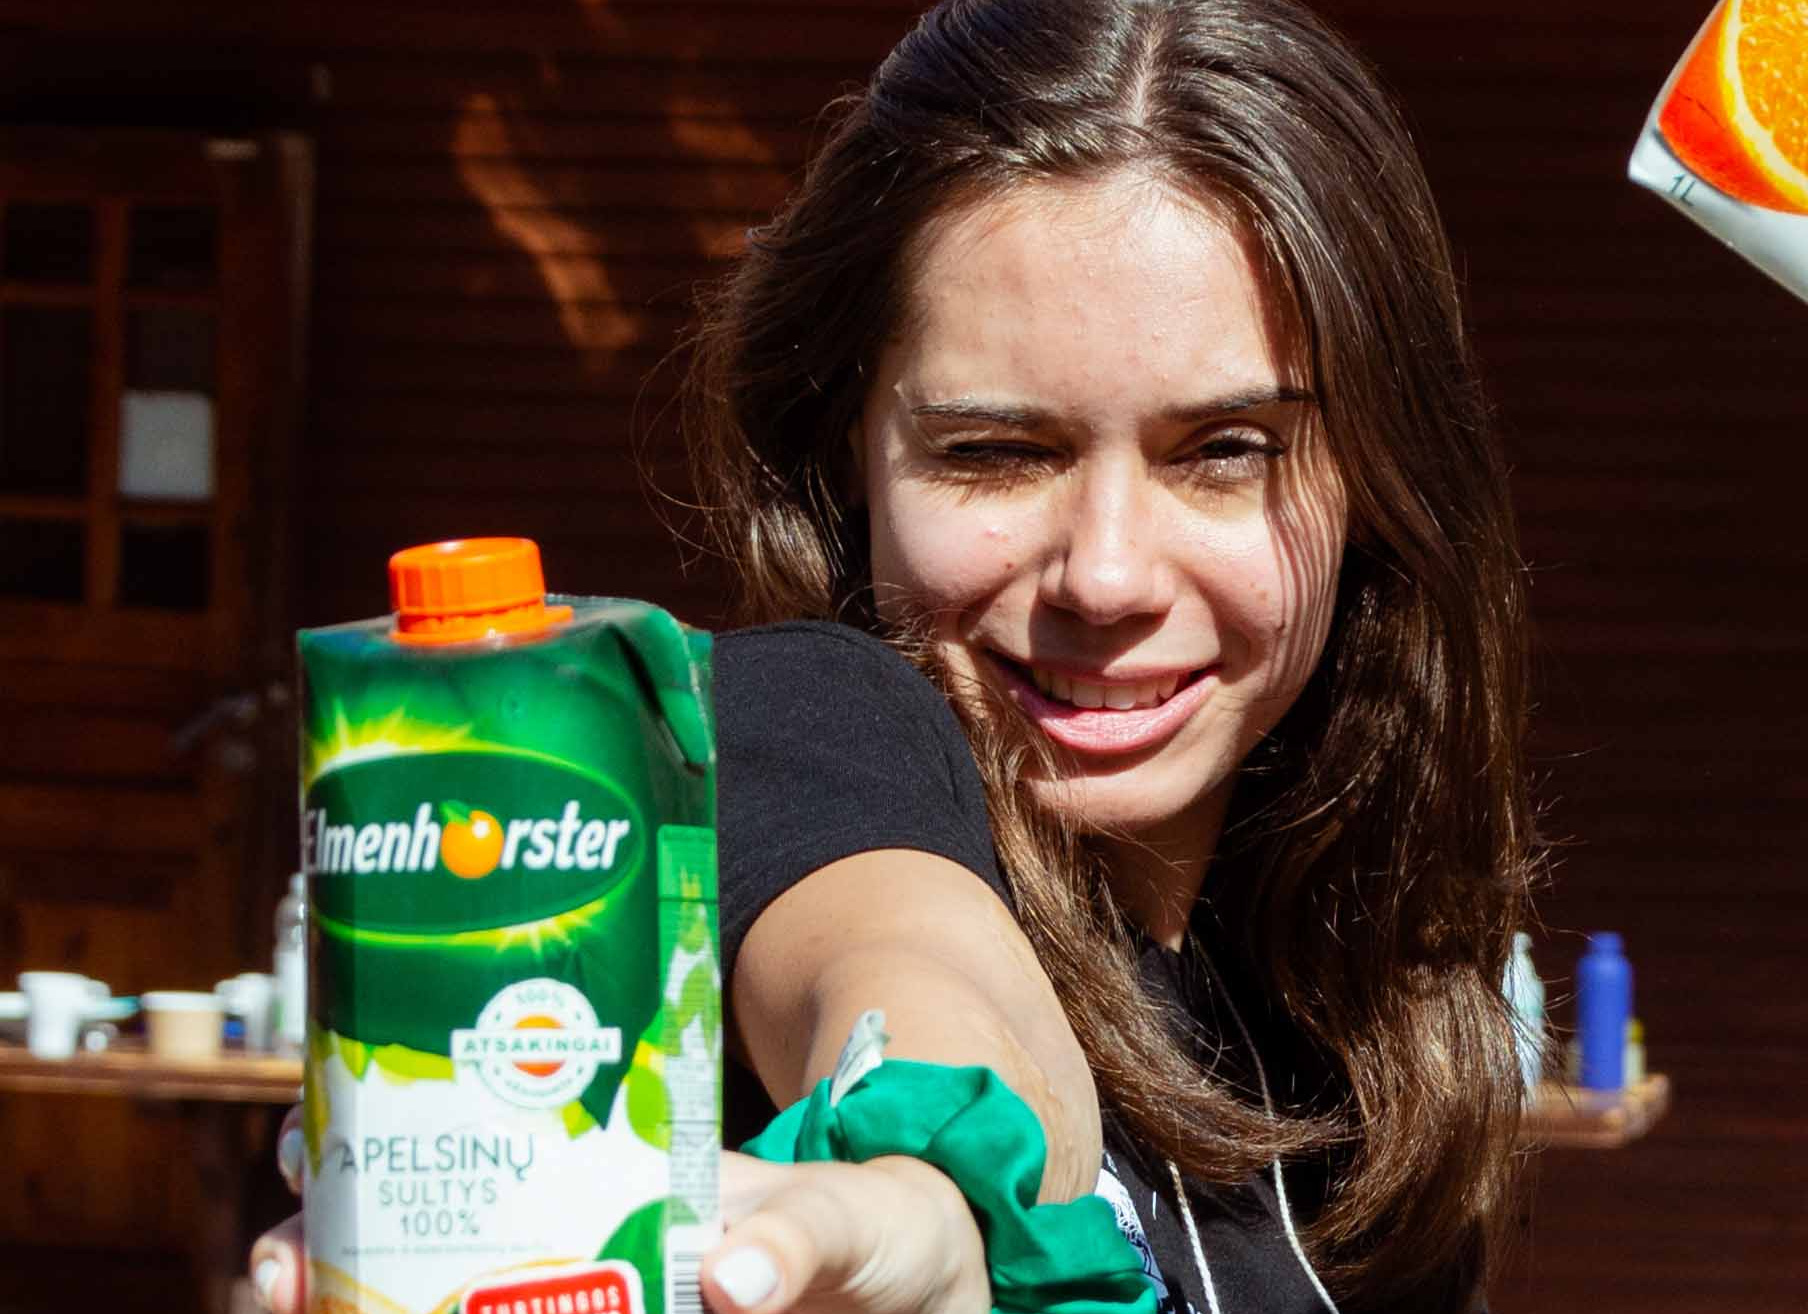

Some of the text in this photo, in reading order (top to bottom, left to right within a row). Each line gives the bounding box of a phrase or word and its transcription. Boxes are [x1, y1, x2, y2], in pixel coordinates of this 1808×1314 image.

[463, 1037, 611, 1052] ATSAKINGAI
[339, 1134, 535, 1181] APELSINŲ
[379, 1177, 497, 1206] SULTYS
[400, 1210, 480, 1236] 100%
